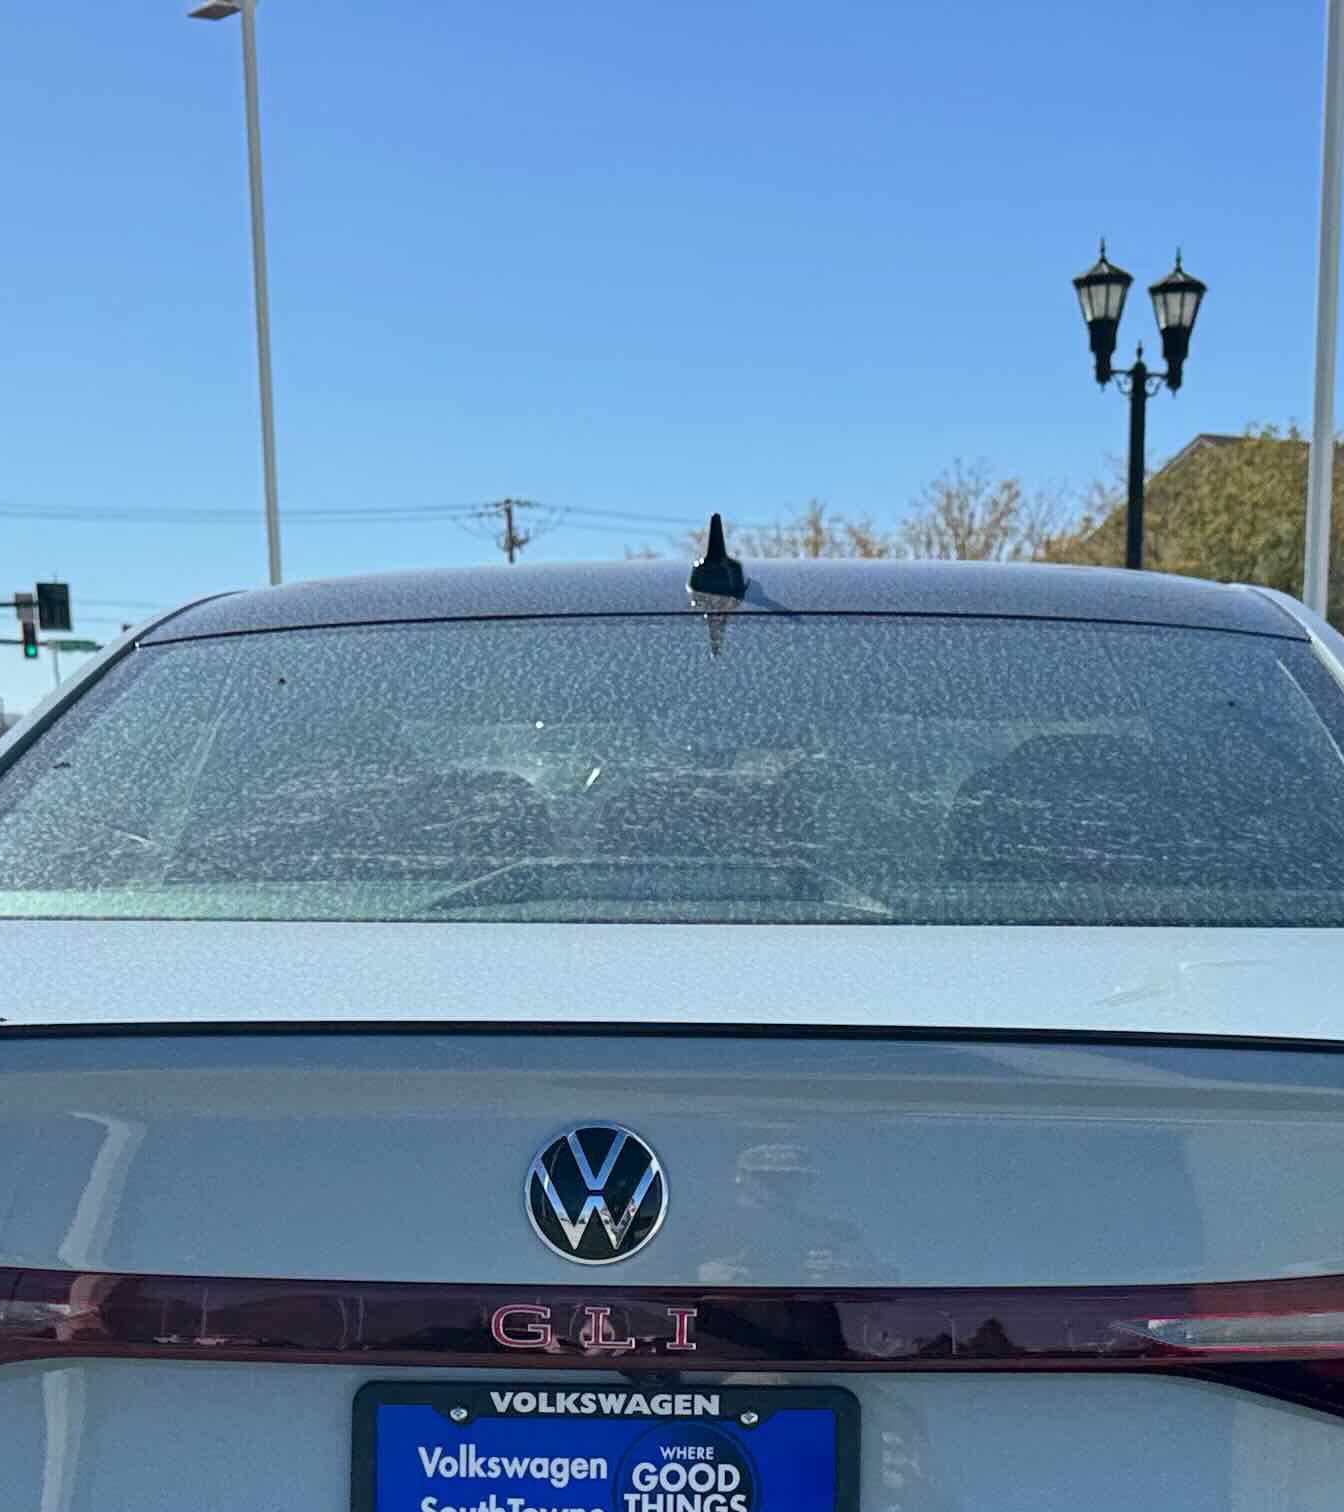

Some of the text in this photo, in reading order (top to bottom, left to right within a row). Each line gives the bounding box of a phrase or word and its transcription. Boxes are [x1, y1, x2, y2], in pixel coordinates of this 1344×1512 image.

[491, 1303, 698, 1351] GLI
[490, 1391, 720, 1417] VOLKSWAGEN
[418, 1444, 608, 1487] Volkswagen
[659, 1446, 715, 1460] WHERE
[631, 1462, 741, 1494] GOOD
